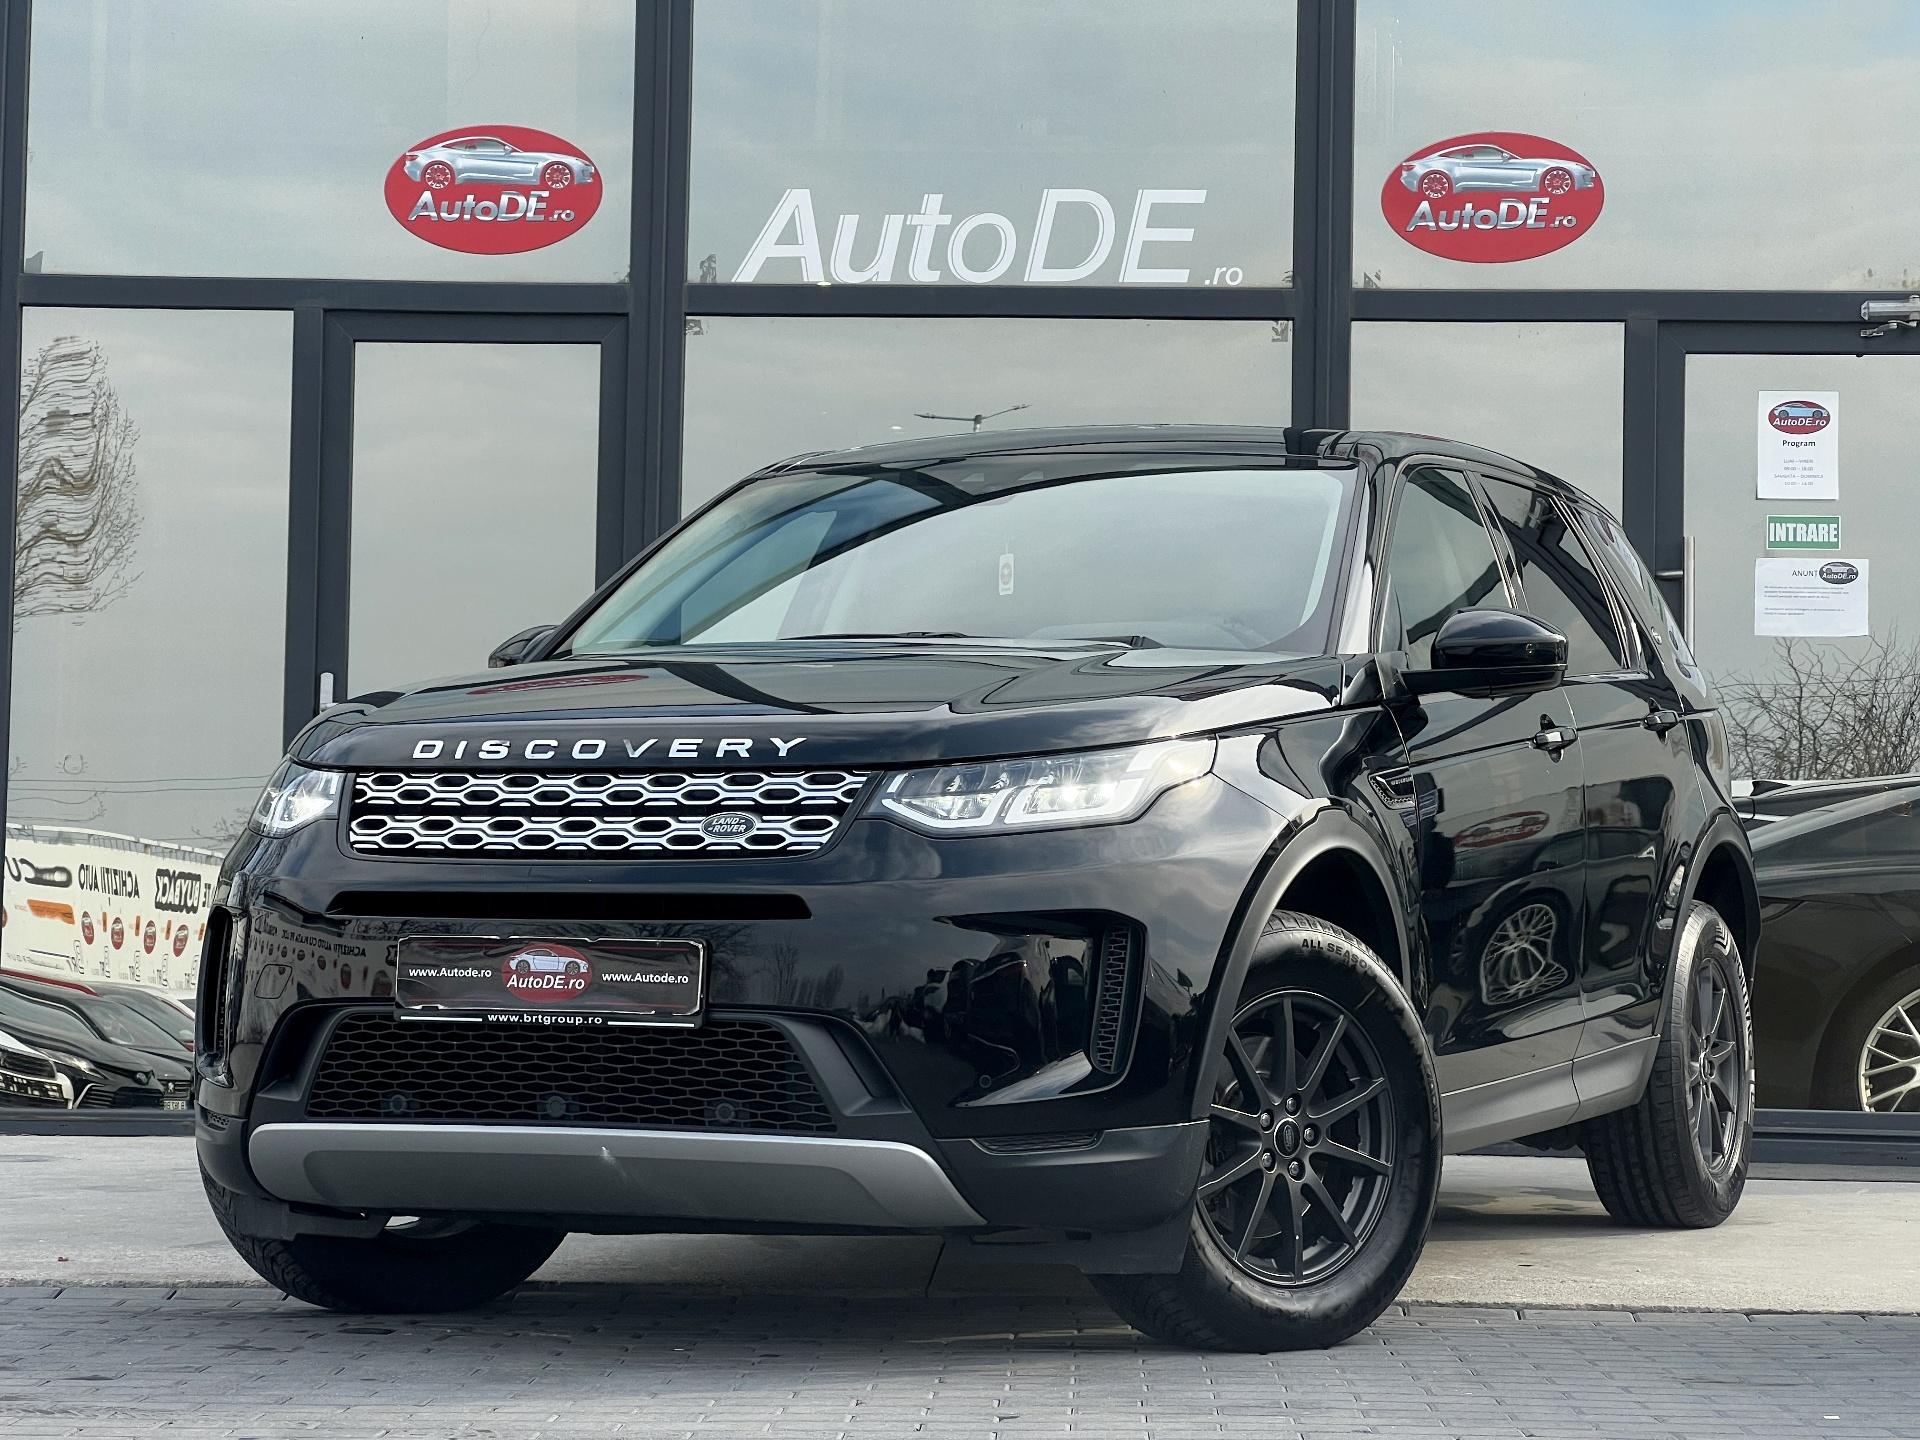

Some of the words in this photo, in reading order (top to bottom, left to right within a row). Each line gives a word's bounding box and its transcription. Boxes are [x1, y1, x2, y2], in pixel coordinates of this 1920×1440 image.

[1772, 417, 1827, 427] AutoDE.ro
[1782, 440, 1816, 448] Program
[1769, 522, 1838, 542] INTRARE
[411, 737, 808, 760] DISCOVERY
[711, 817, 740, 825] LAND
[712, 825, 747, 833] ROVER
[1302, 938, 1323, 950] ALL
[408, 966, 492, 978] www.Autode.ro
[601, 971, 689, 984] www.Autode.ro
[506, 974, 586, 990] AutoDE.ro
[487, 1013, 603, 1026] www.brtgroup.ro
